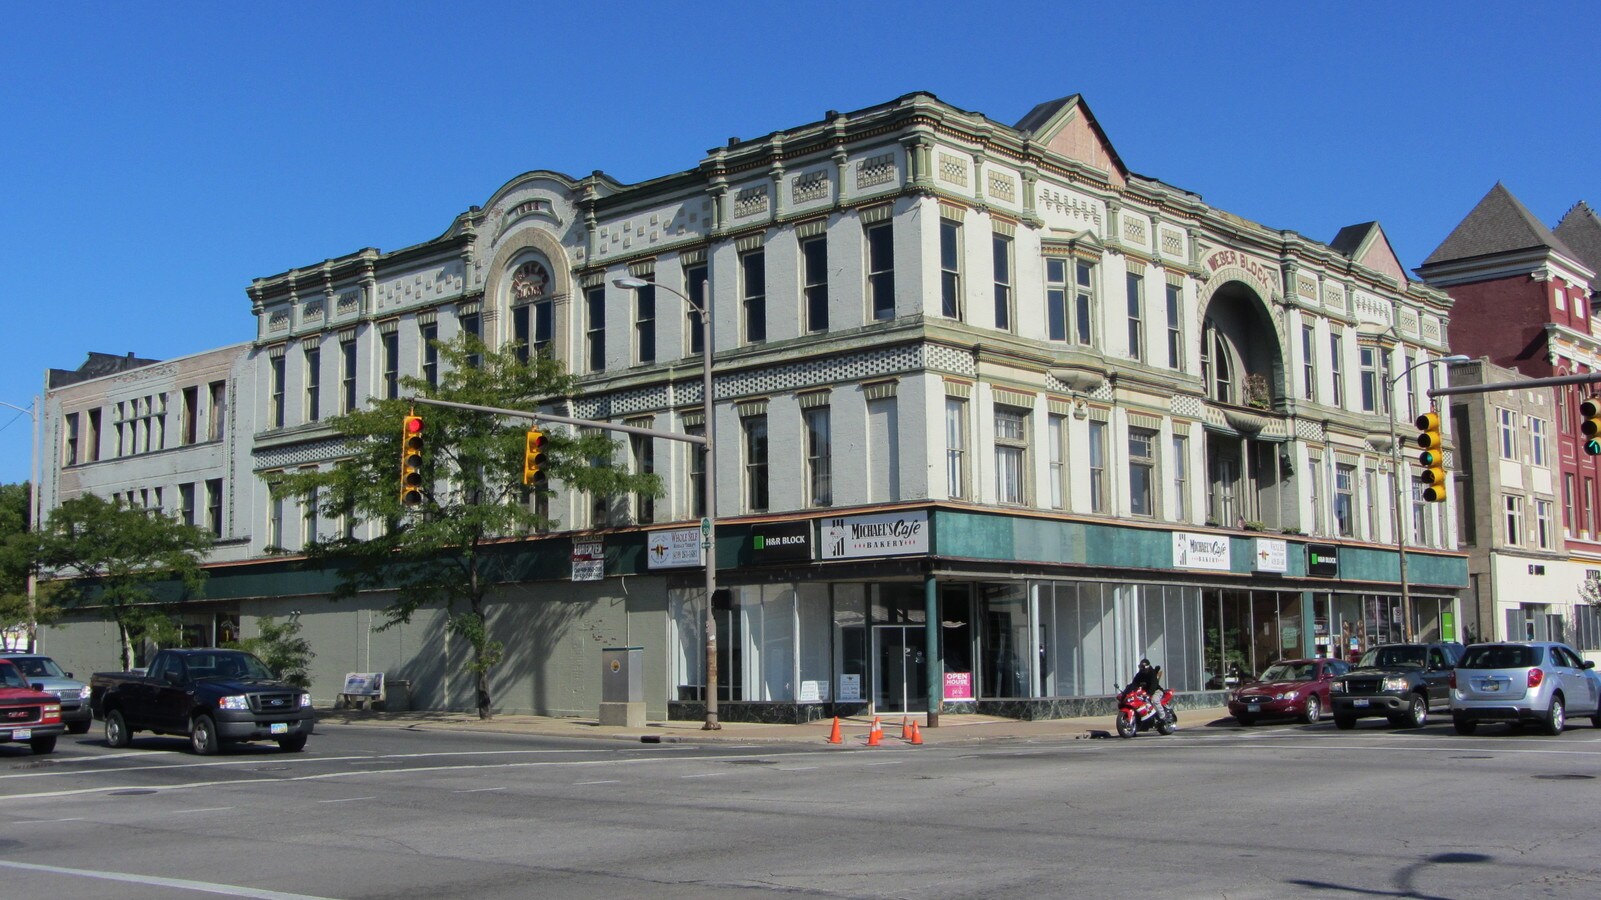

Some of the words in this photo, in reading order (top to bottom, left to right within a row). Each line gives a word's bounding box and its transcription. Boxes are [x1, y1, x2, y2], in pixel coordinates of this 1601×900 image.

[1208, 250, 1236, 272] WEBER
[1240, 253, 1269, 289] BLOCK
[766, 537, 781, 546] H&R
[782, 535, 805, 545] BLOCK
[866, 540, 903, 548] BAKERY
[1326, 556, 1337, 564] BLOCK
